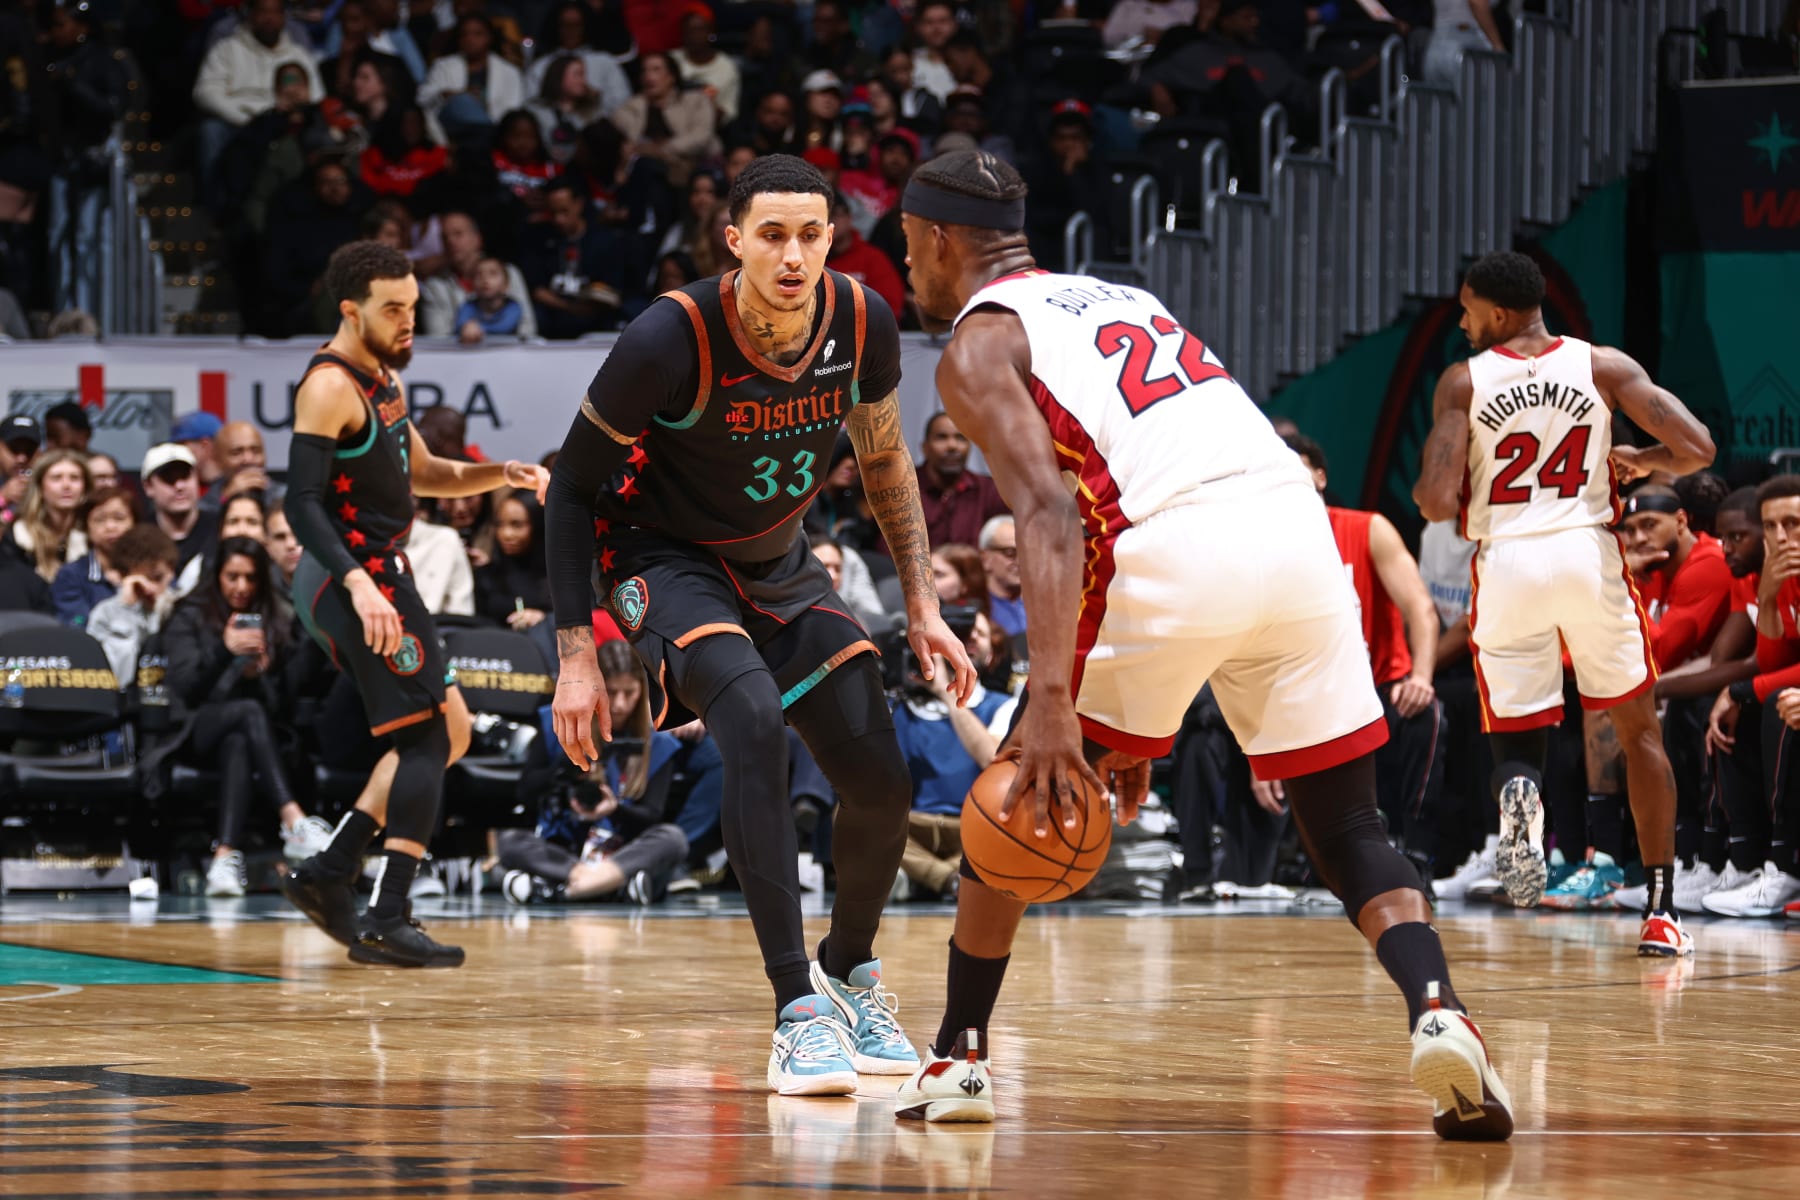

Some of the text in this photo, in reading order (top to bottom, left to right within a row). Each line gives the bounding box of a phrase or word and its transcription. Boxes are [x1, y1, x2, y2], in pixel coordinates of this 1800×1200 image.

[814, 361, 852, 377] Robinhood
[1094, 314, 1236, 419] 22
[725, 385, 845, 434] the District
[764, 418, 839, 441] COLUMBIA
[1477, 381, 1595, 432] HIGHSMITH
[743, 449, 817, 503] 33
[1488, 424, 1592, 506] 24
[449, 657, 513, 672] AESARS
